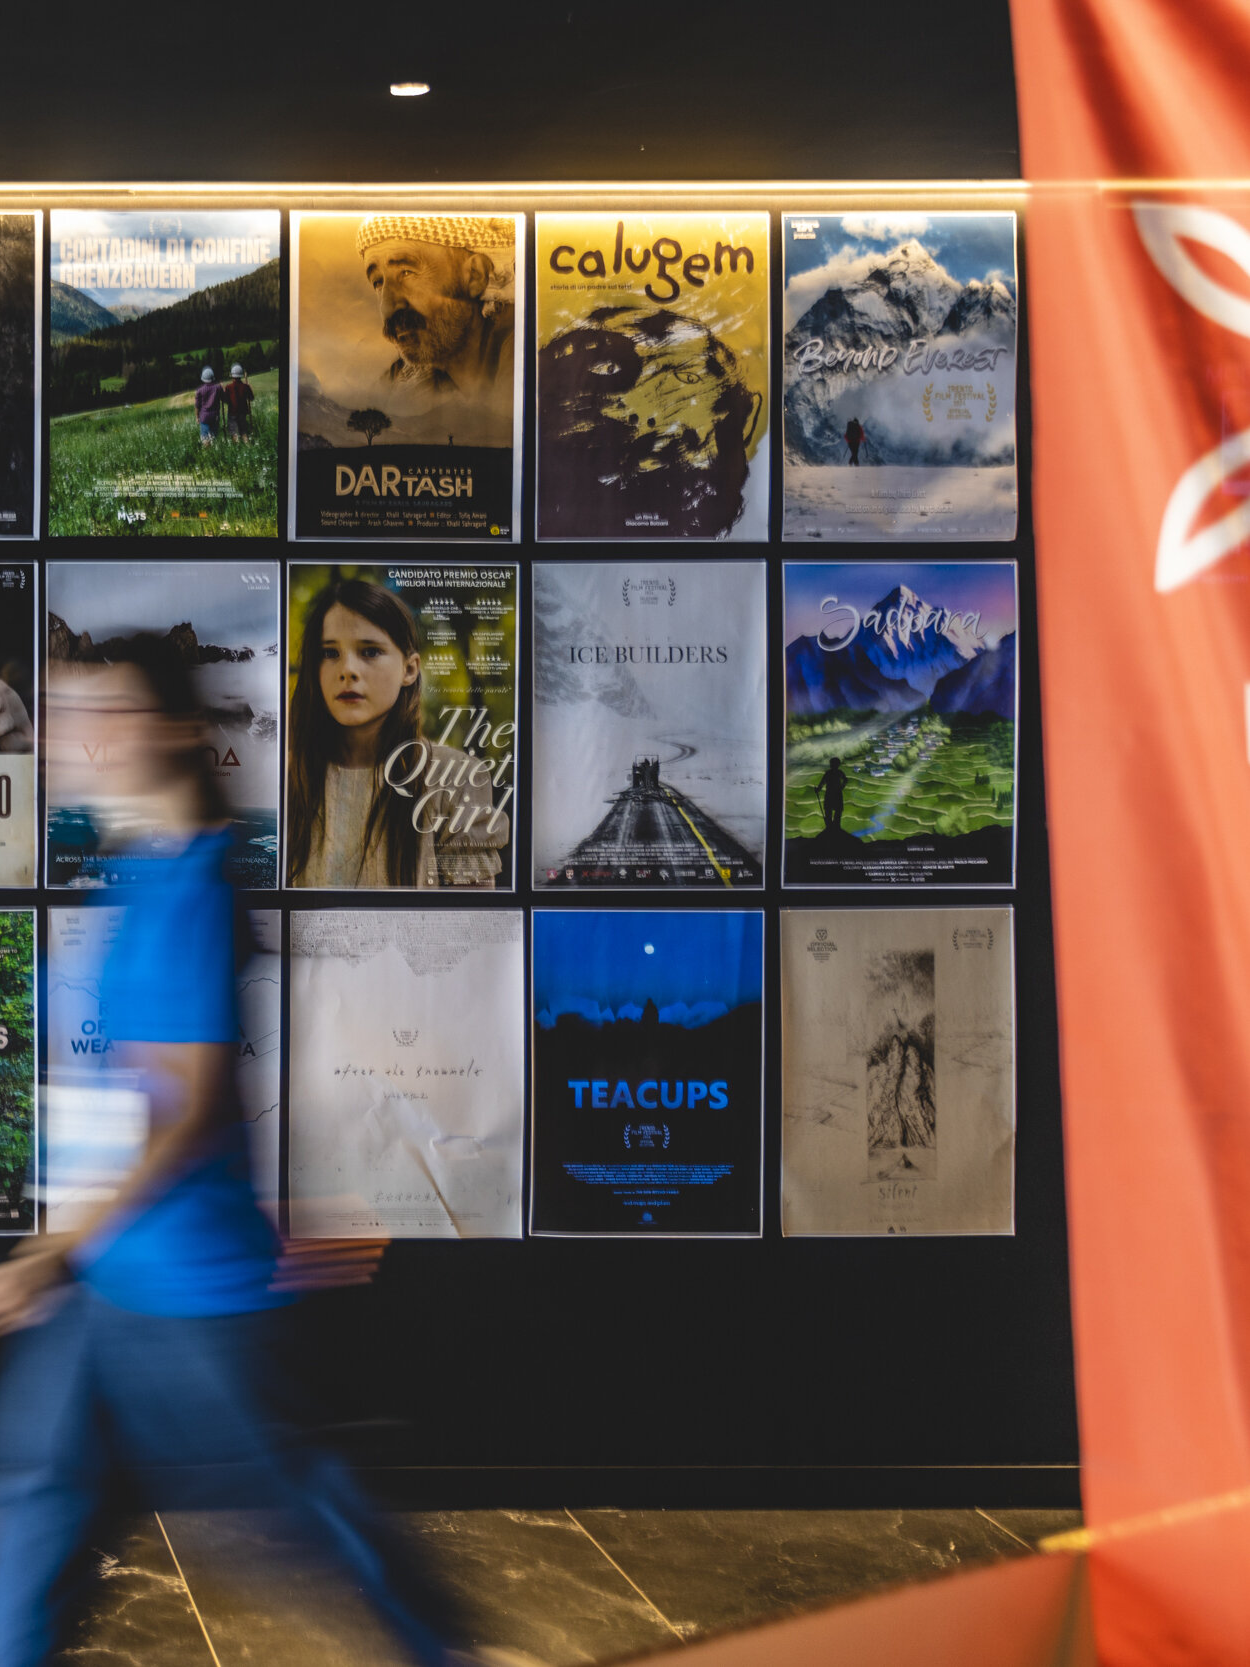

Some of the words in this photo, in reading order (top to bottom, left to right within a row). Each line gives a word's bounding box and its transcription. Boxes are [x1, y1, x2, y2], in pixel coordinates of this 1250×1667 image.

[60, 237, 160, 264] CONTADINI
[166, 238, 185, 264] DI
[191, 238, 271, 264] CONFINE
[550, 221, 754, 304] calugem
[60, 264, 196, 289] GRENZBAUERN
[321, 519, 337, 527] Sound
[437, 511, 452, 519] Editor
[389, 569, 441, 579] CANDIDATO
[443, 570, 478, 579] PREMIO
[445, 580, 506, 588] INTERNAZIONALE
[816, 595, 989, 652] Sadpara
[569, 645, 608, 664] ICE
[614, 645, 728, 664] BUILDERS
[439, 705, 515, 749] The
[384, 741, 515, 798] Quiet
[412, 786, 514, 834] Girl
[56, 855, 82, 863] ACROSS
[567, 1079, 729, 1110] TEACUPS
